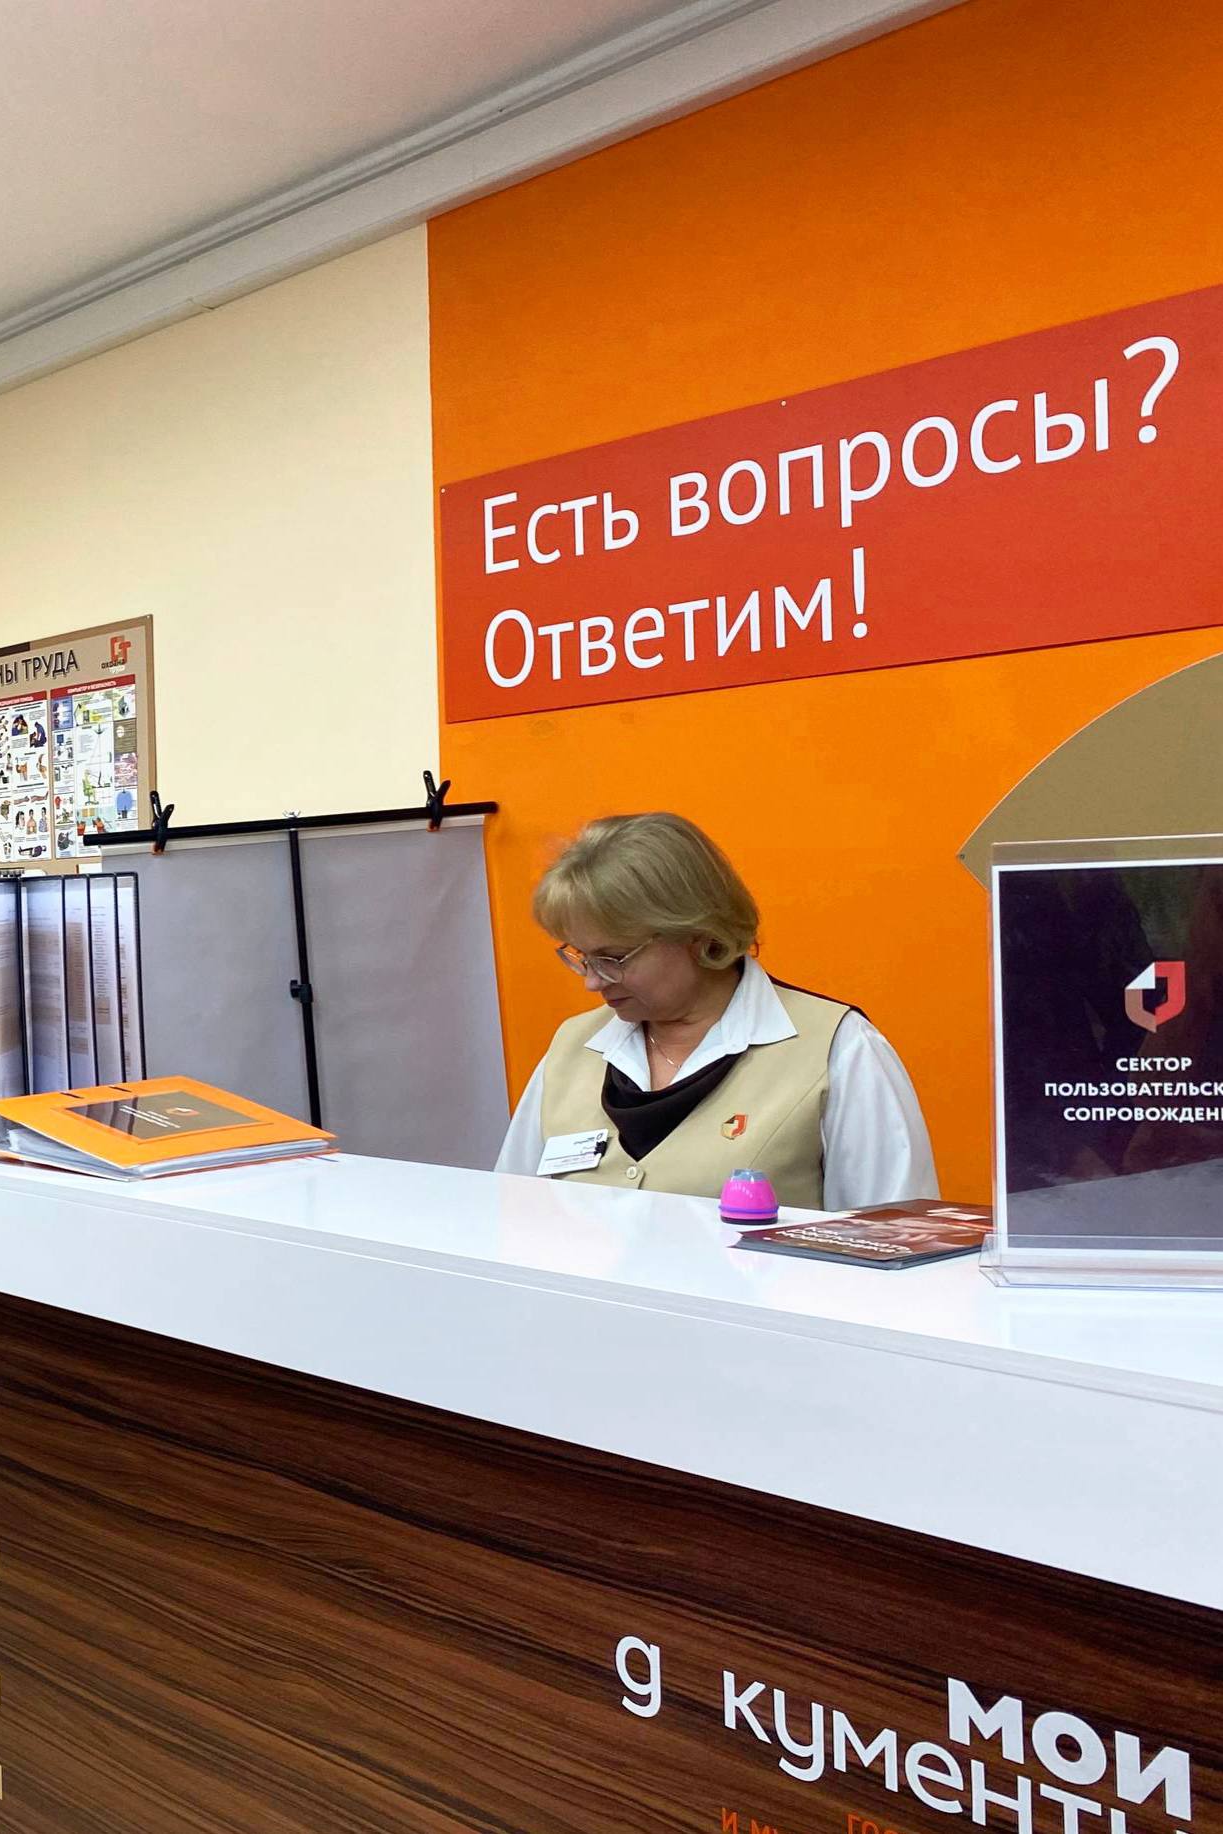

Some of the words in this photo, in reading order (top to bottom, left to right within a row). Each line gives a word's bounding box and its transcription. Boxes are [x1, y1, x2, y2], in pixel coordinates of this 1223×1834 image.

[483, 491, 639, 574] Есть
[669, 336, 1180, 537] вопросы?
[484, 547, 868, 688] Ответим!
[21, 649, 79, 680] ТРУДА
[1115, 1056, 1193, 1072] СЕКТОР
[1063, 1107, 1223, 1124] СОПРОВОЖДЕН
